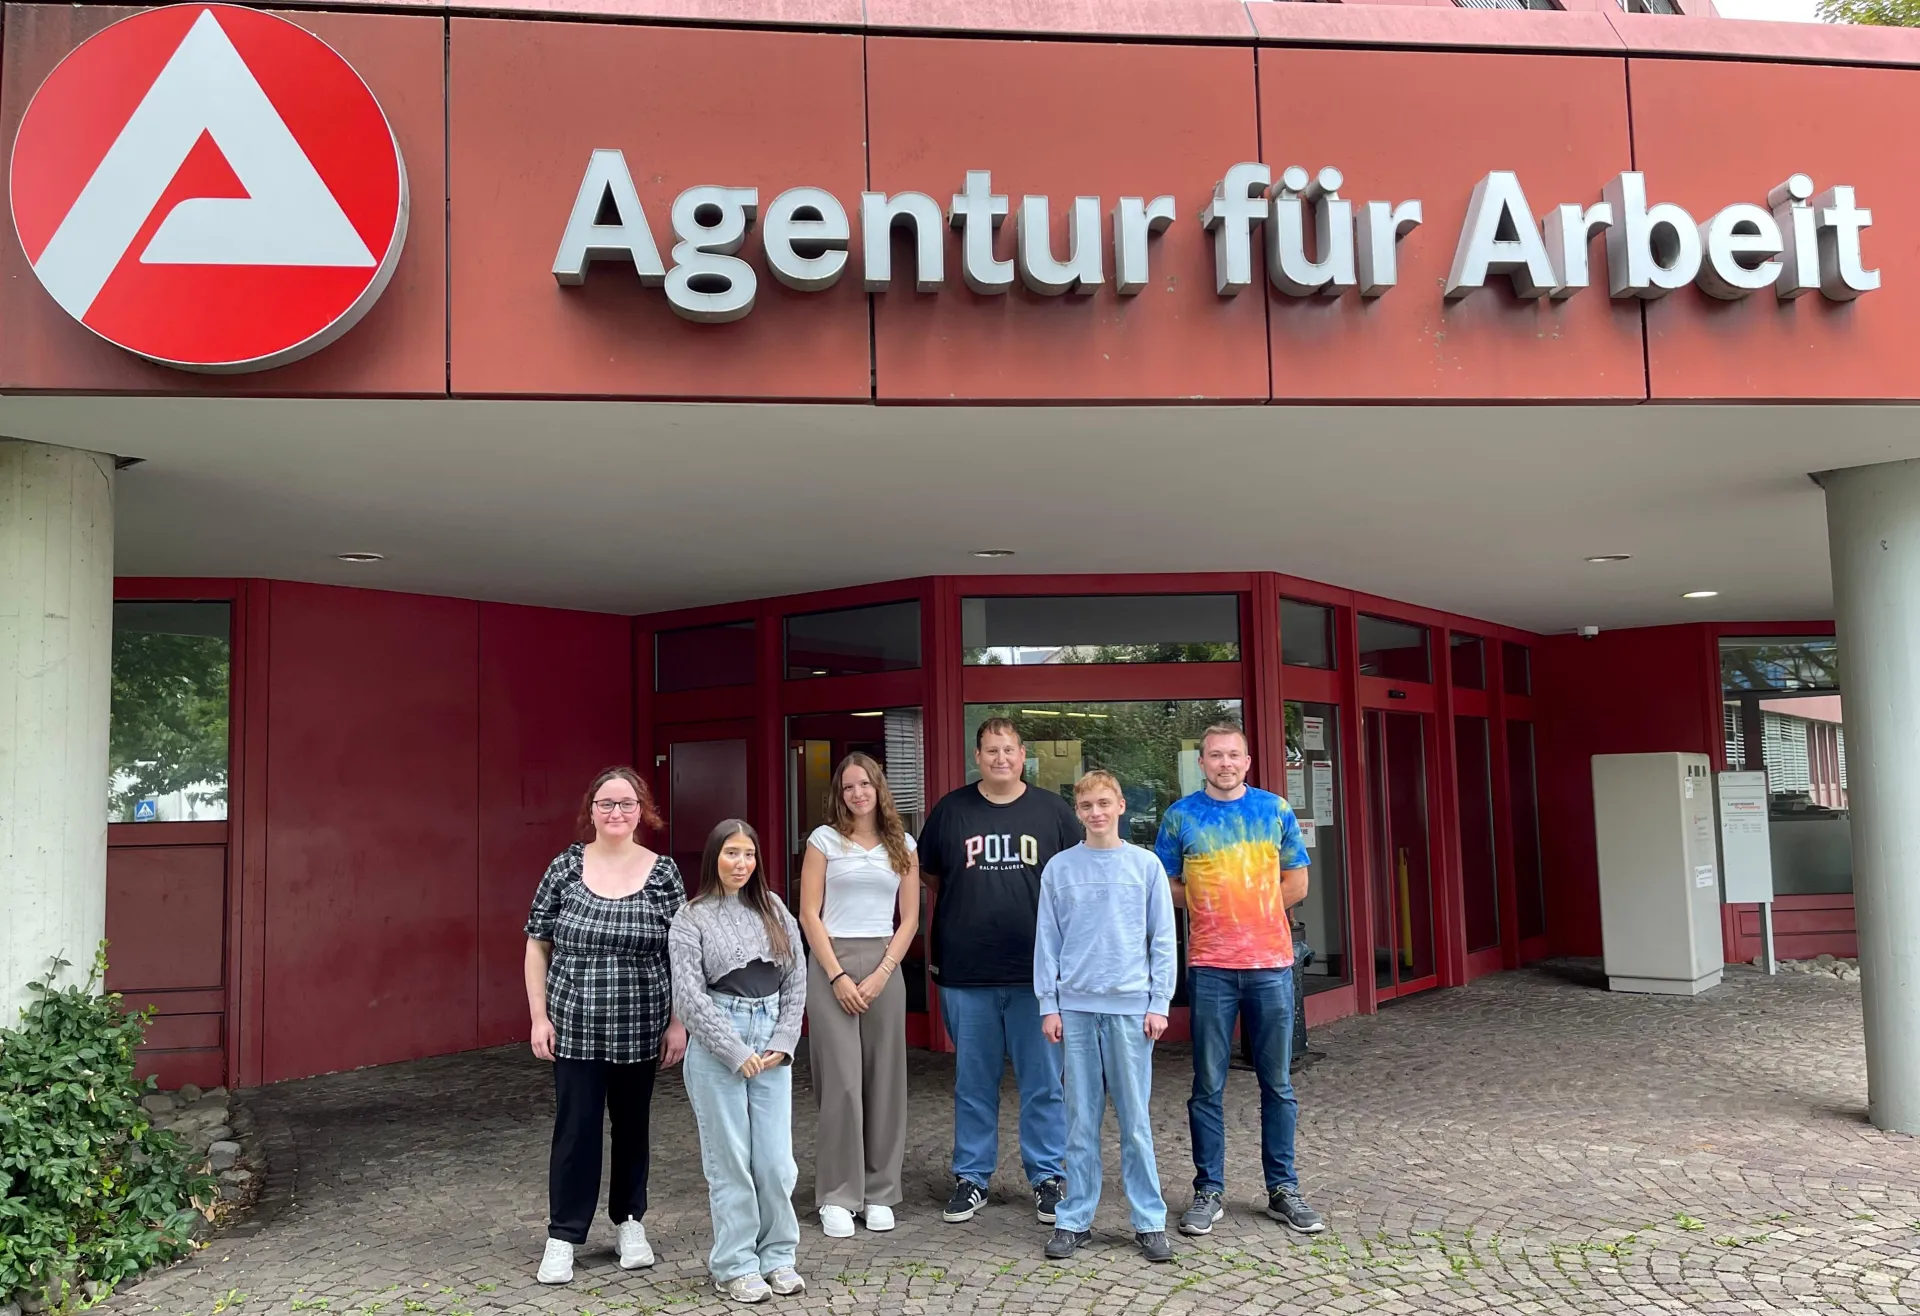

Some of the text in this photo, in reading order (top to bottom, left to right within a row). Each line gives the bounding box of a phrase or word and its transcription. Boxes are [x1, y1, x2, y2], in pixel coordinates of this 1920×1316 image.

[552, 148, 1881, 322] Agentur für Arbeit
[965, 834, 1038, 869] POLO
